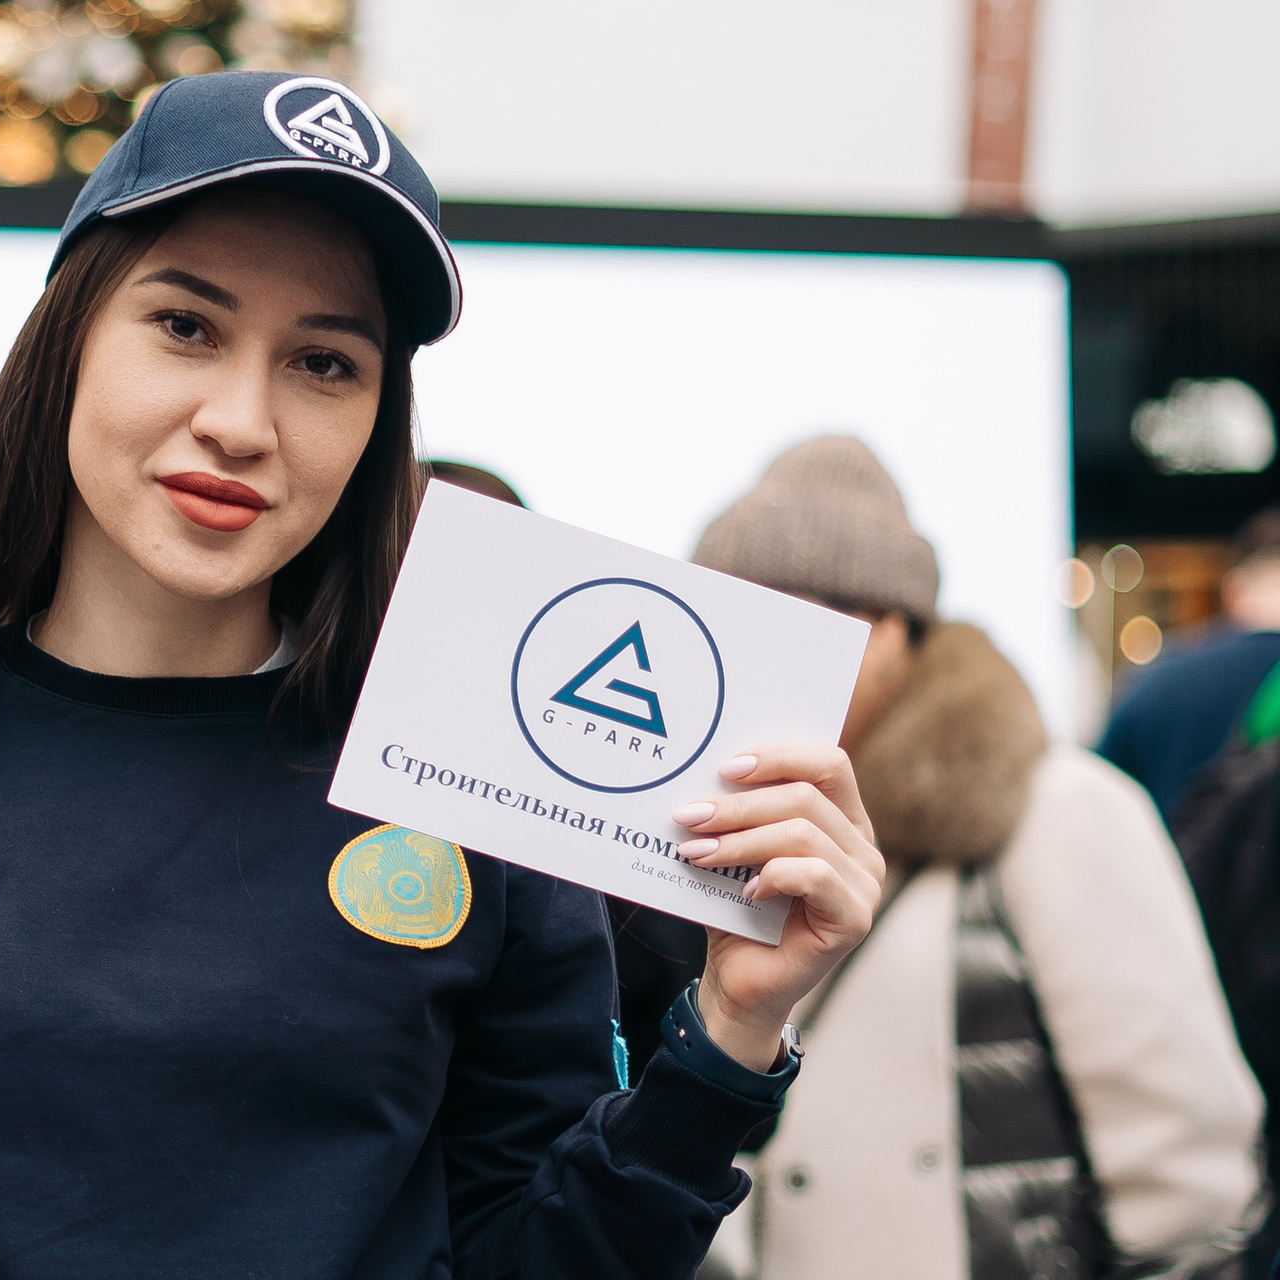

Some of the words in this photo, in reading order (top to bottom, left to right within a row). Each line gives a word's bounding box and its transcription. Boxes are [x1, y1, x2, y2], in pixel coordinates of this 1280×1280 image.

[289, 128, 363, 168] G-PARK
[542, 709, 666, 760] G-PARK
[381, 744, 607, 836] Строительная
[631, 856, 654, 875] для
[657, 868, 684, 888] всех
